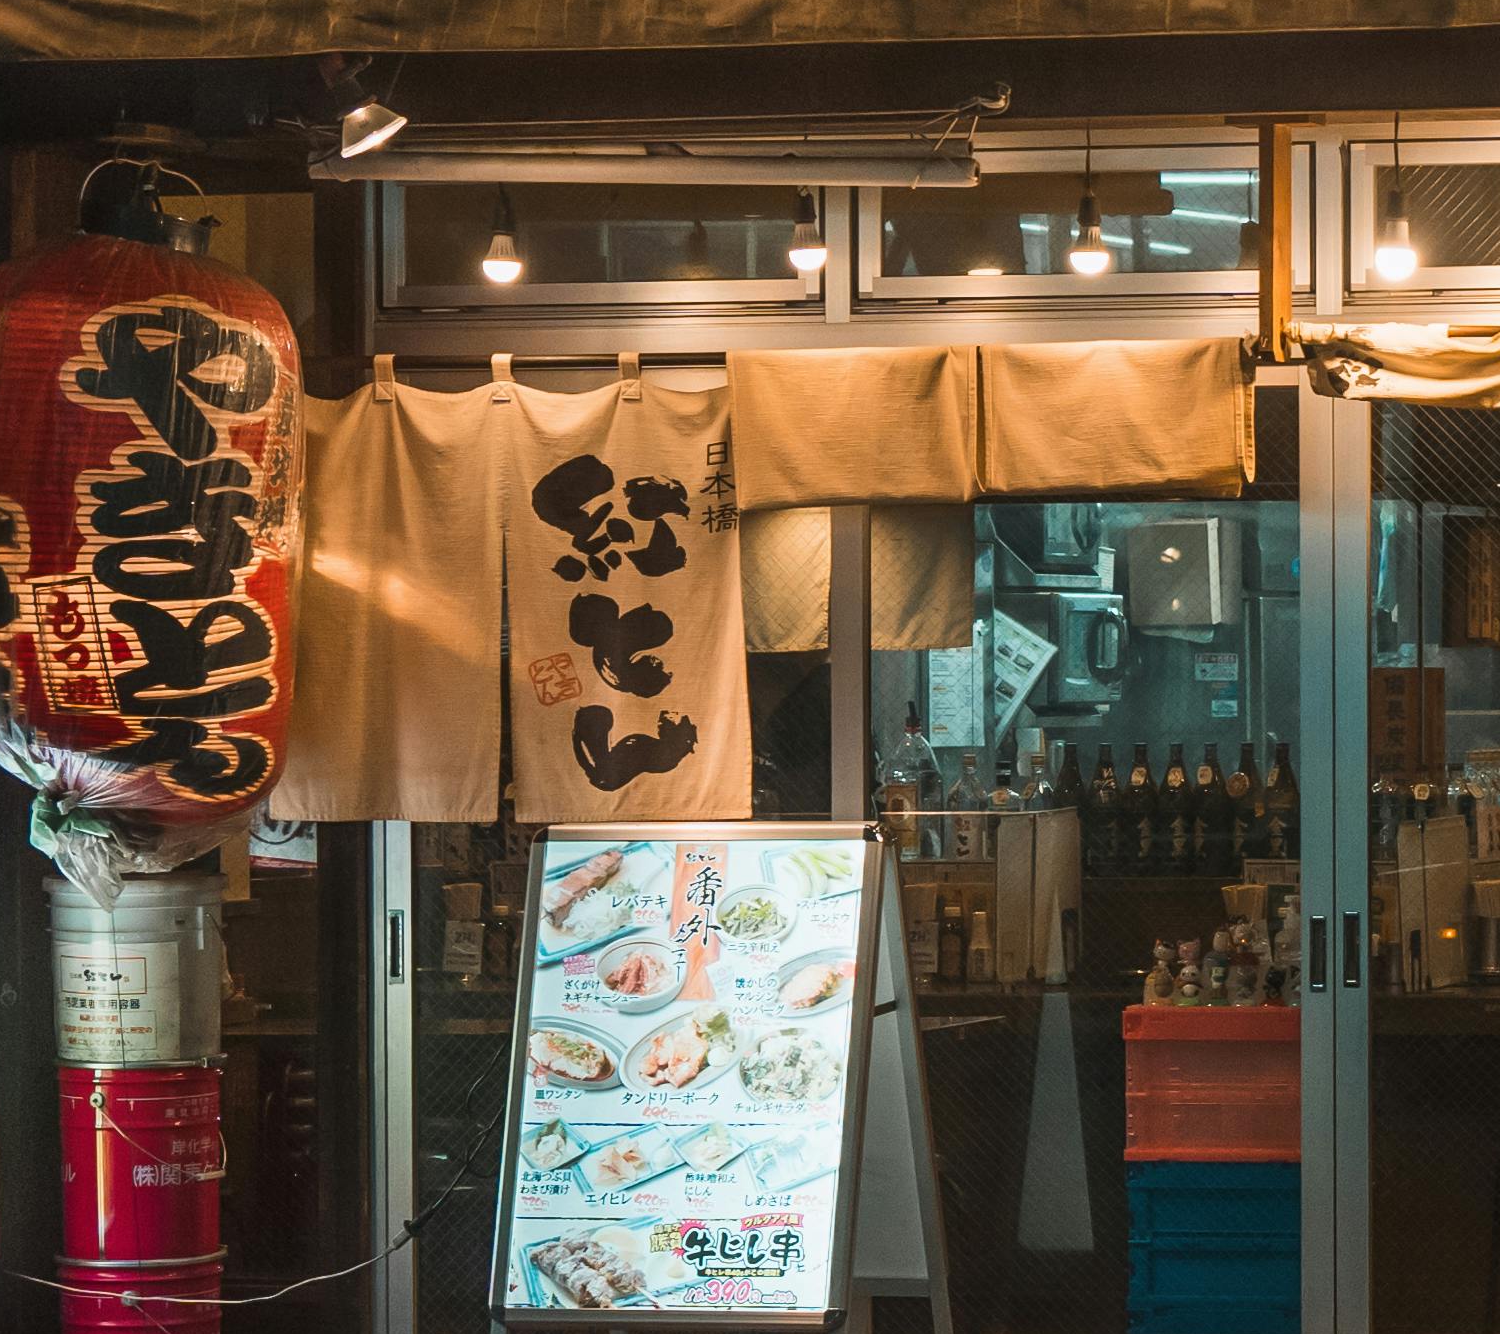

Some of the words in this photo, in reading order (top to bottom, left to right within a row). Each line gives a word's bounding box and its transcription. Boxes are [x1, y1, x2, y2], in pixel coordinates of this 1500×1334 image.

[701, 441, 740, 534] 日本橋
[72, 303, 280, 797] やきとん
[532, 454, 699, 793] 紅とん
[611, 895, 668, 909] レバテキ
[811, 912, 850, 923] エンドウ
[733, 1004, 785, 1016] ハンバーグ
[621, 1092, 721, 1107] タンドリーポーク
[520, 1183, 571, 1196] わさび漬け
[684, 1185, 714, 1197] にしん
[585, 1193, 630, 1207] エイヒレ
[744, 1194, 791, 1208] しめさば
